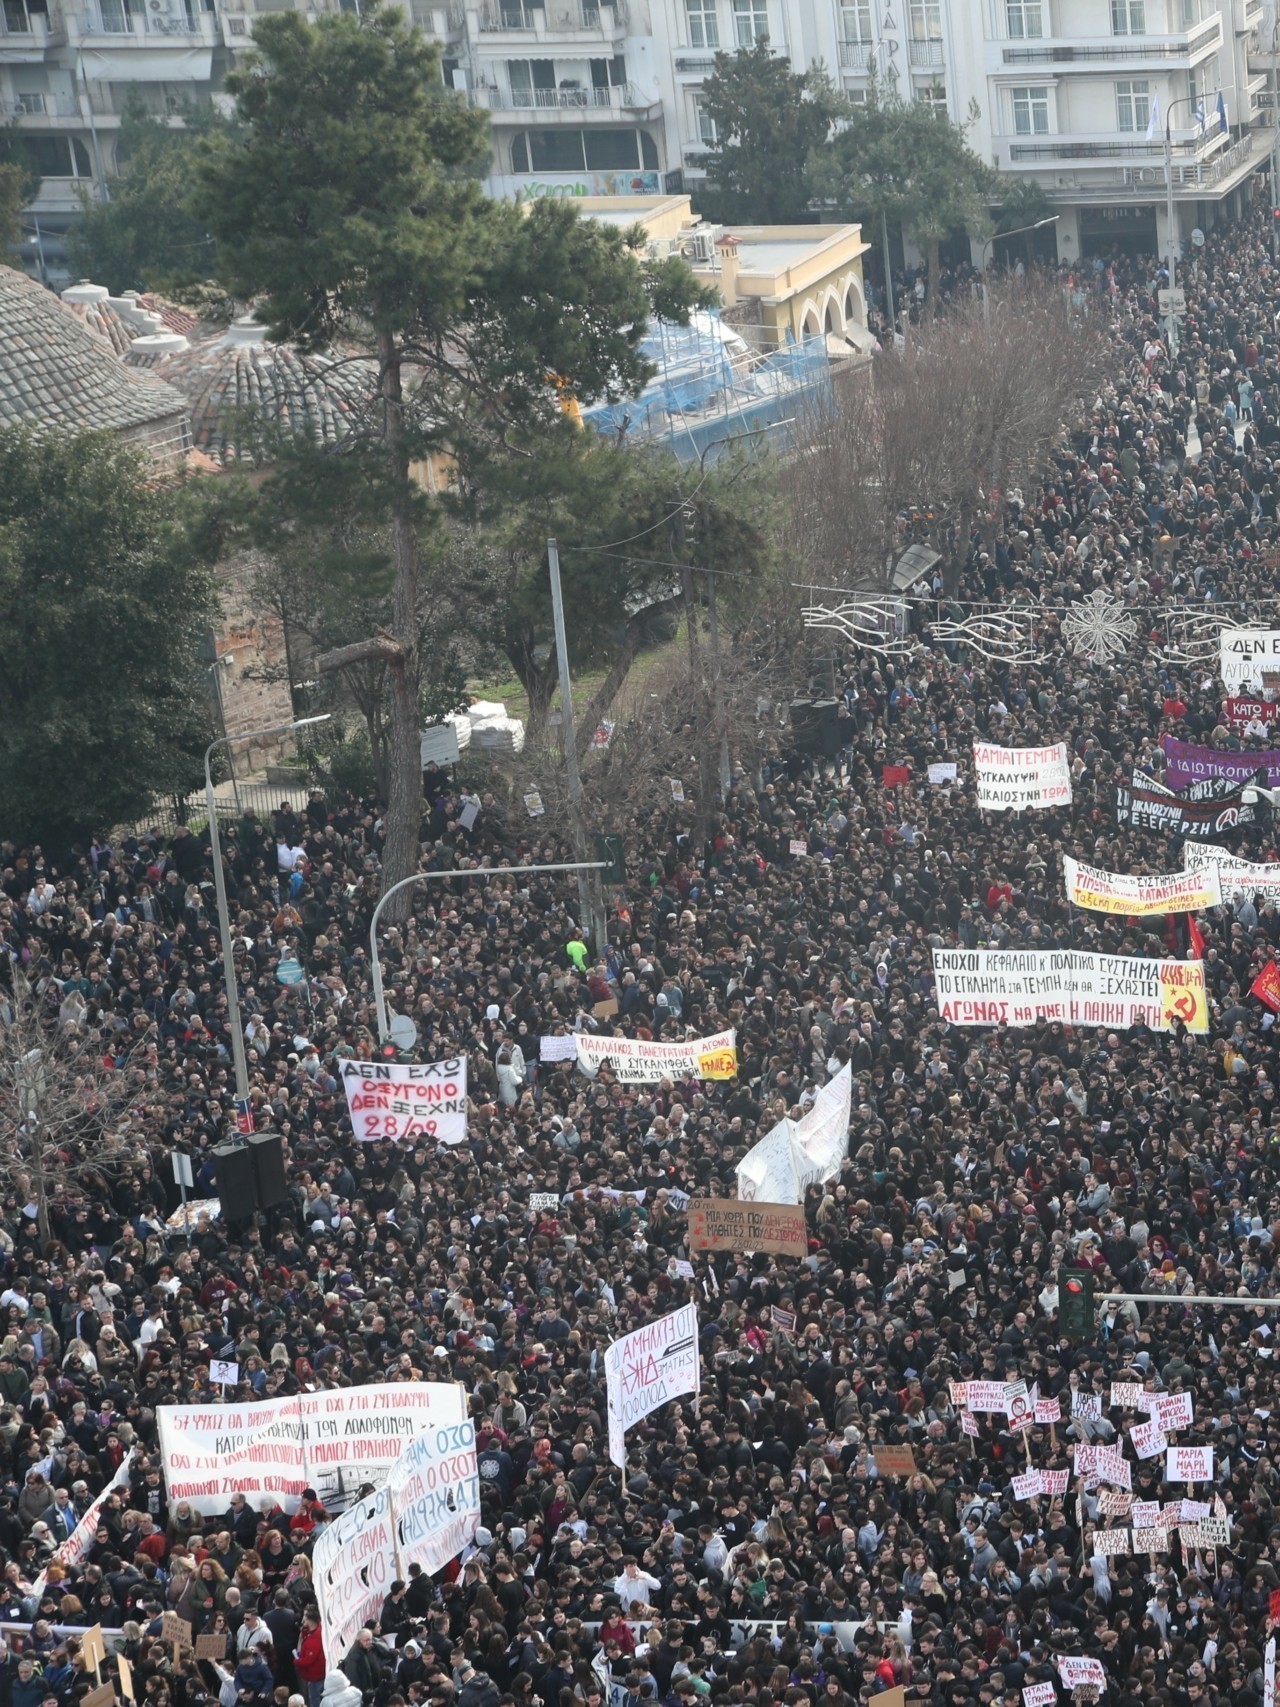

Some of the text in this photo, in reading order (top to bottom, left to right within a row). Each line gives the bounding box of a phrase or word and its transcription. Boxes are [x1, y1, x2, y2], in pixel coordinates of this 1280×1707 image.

[1225, 664, 1250, 679] ΑΥΤΟ
[1015, 746, 1060, 765] ΤΕΜΠΗ
[977, 786, 1068, 803] ΔΙΚΑΙΟΣΥΝΗ ΤΩΡΑ
[1132, 800, 1182, 820] ΔΙΚΑΙΟΣΥΝΗ
[1132, 814, 1210, 835] ΕΞΕΓΕΡΣΗ
[1136, 875, 1176, 888] ΣΥΣΤΗΜΑ
[1138, 875, 1204, 902] ΚΑΤΑΚΤΗΣΕΙΣ
[934, 953, 1160, 980] ΕΝΟΧΟΙ ΚΕΦΑΛΑΙΟ ΠΟΛΙΤΙΚΟ ΣΥΣΤΗΜΑ
[938, 975, 952, 994] ΤΟ
[954, 976, 1006, 994] ΕΓΚΛΗΜΑ
[1008, 982, 1022, 994] ΣΤΑ
[1022, 974, 1062, 994] ΤΕΜΠΗ
[1082, 981, 1092, 992] ΘΑ
[1100, 978, 1158, 997] ΞΕΧΑΣΤΕΙ
[942, 1000, 1008, 1022] ΑΓΩΝΑΣ
[1014, 1006, 1032, 1020] ΝΑ
[1036, 1004, 1066, 1018] ΓΙΝΕΙ
[1070, 1000, 1078, 1020] Η
[638, 1044, 696, 1058] ΠΑΝΕΡΓΑΤΙΚΟΣ
[344, 1058, 460, 1080] ΔΕΝ ΕΧΩ
[588, 1054, 600, 1066] ΝΑ
[628, 1054, 694, 1070] ΣΥΓΚΑΛΥΦΘΕΙ
[615, 1068, 646, 1080] ΓΚΛΗΜΑ
[650, 1069, 665, 1079] ΣΤΑ
[362, 1080, 458, 1102] ΟΞΥΓΟΝΟ
[351, 1094, 465, 1116] ΔΕΝ ΞΕΧΝΩ
[706, 1210, 720, 1222] ΜΙΑ
[723, 1211, 745, 1224] ΧΩΡΑ
[748, 1212, 764, 1225] ΠΟΥ
[707, 1224, 744, 1238] ΜΑΘΗΤΕΣ
[748, 1226, 764, 1238] ΠΟΥ
[174, 1414, 189, 1431] 57
[192, 1414, 224, 1430] ΨΥΧΕΣ
[228, 1414, 242, 1430] ΘΑ
[326, 1398, 344, 1412] ΟΧΙ
[373, 1392, 430, 1409] ΣΥΓΚΑΛΥΨΗ
[986, 1400, 1004, 1408] ΕΤΩΝ
[316, 1416, 414, 1438] ΤΩΝ ΔΟΛΟΦΟΝΩΝ
[1170, 1416, 1190, 1428] ΕΤΩΝ
[170, 1453, 190, 1470] ΟΧΙ
[1177, 1449, 1204, 1459] ΜΑΡΙΑ
[1176, 1460, 1205, 1470] ΜΙΑΡΗ
[1190, 1470, 1208, 1480] ΕΤΩΝ
[1200, 1517, 1225, 1526] ΗΤΑΝ Η
[1096, 1530, 1124, 1541] ΑΘΗΝΑ
[1200, 1525, 1226, 1535] ΚΑΚΙΑ
[1136, 1536, 1166, 1546] ΒΛΑΧΟΣ
[1024, 1684, 1048, 1697] ΗΤΑΝ
